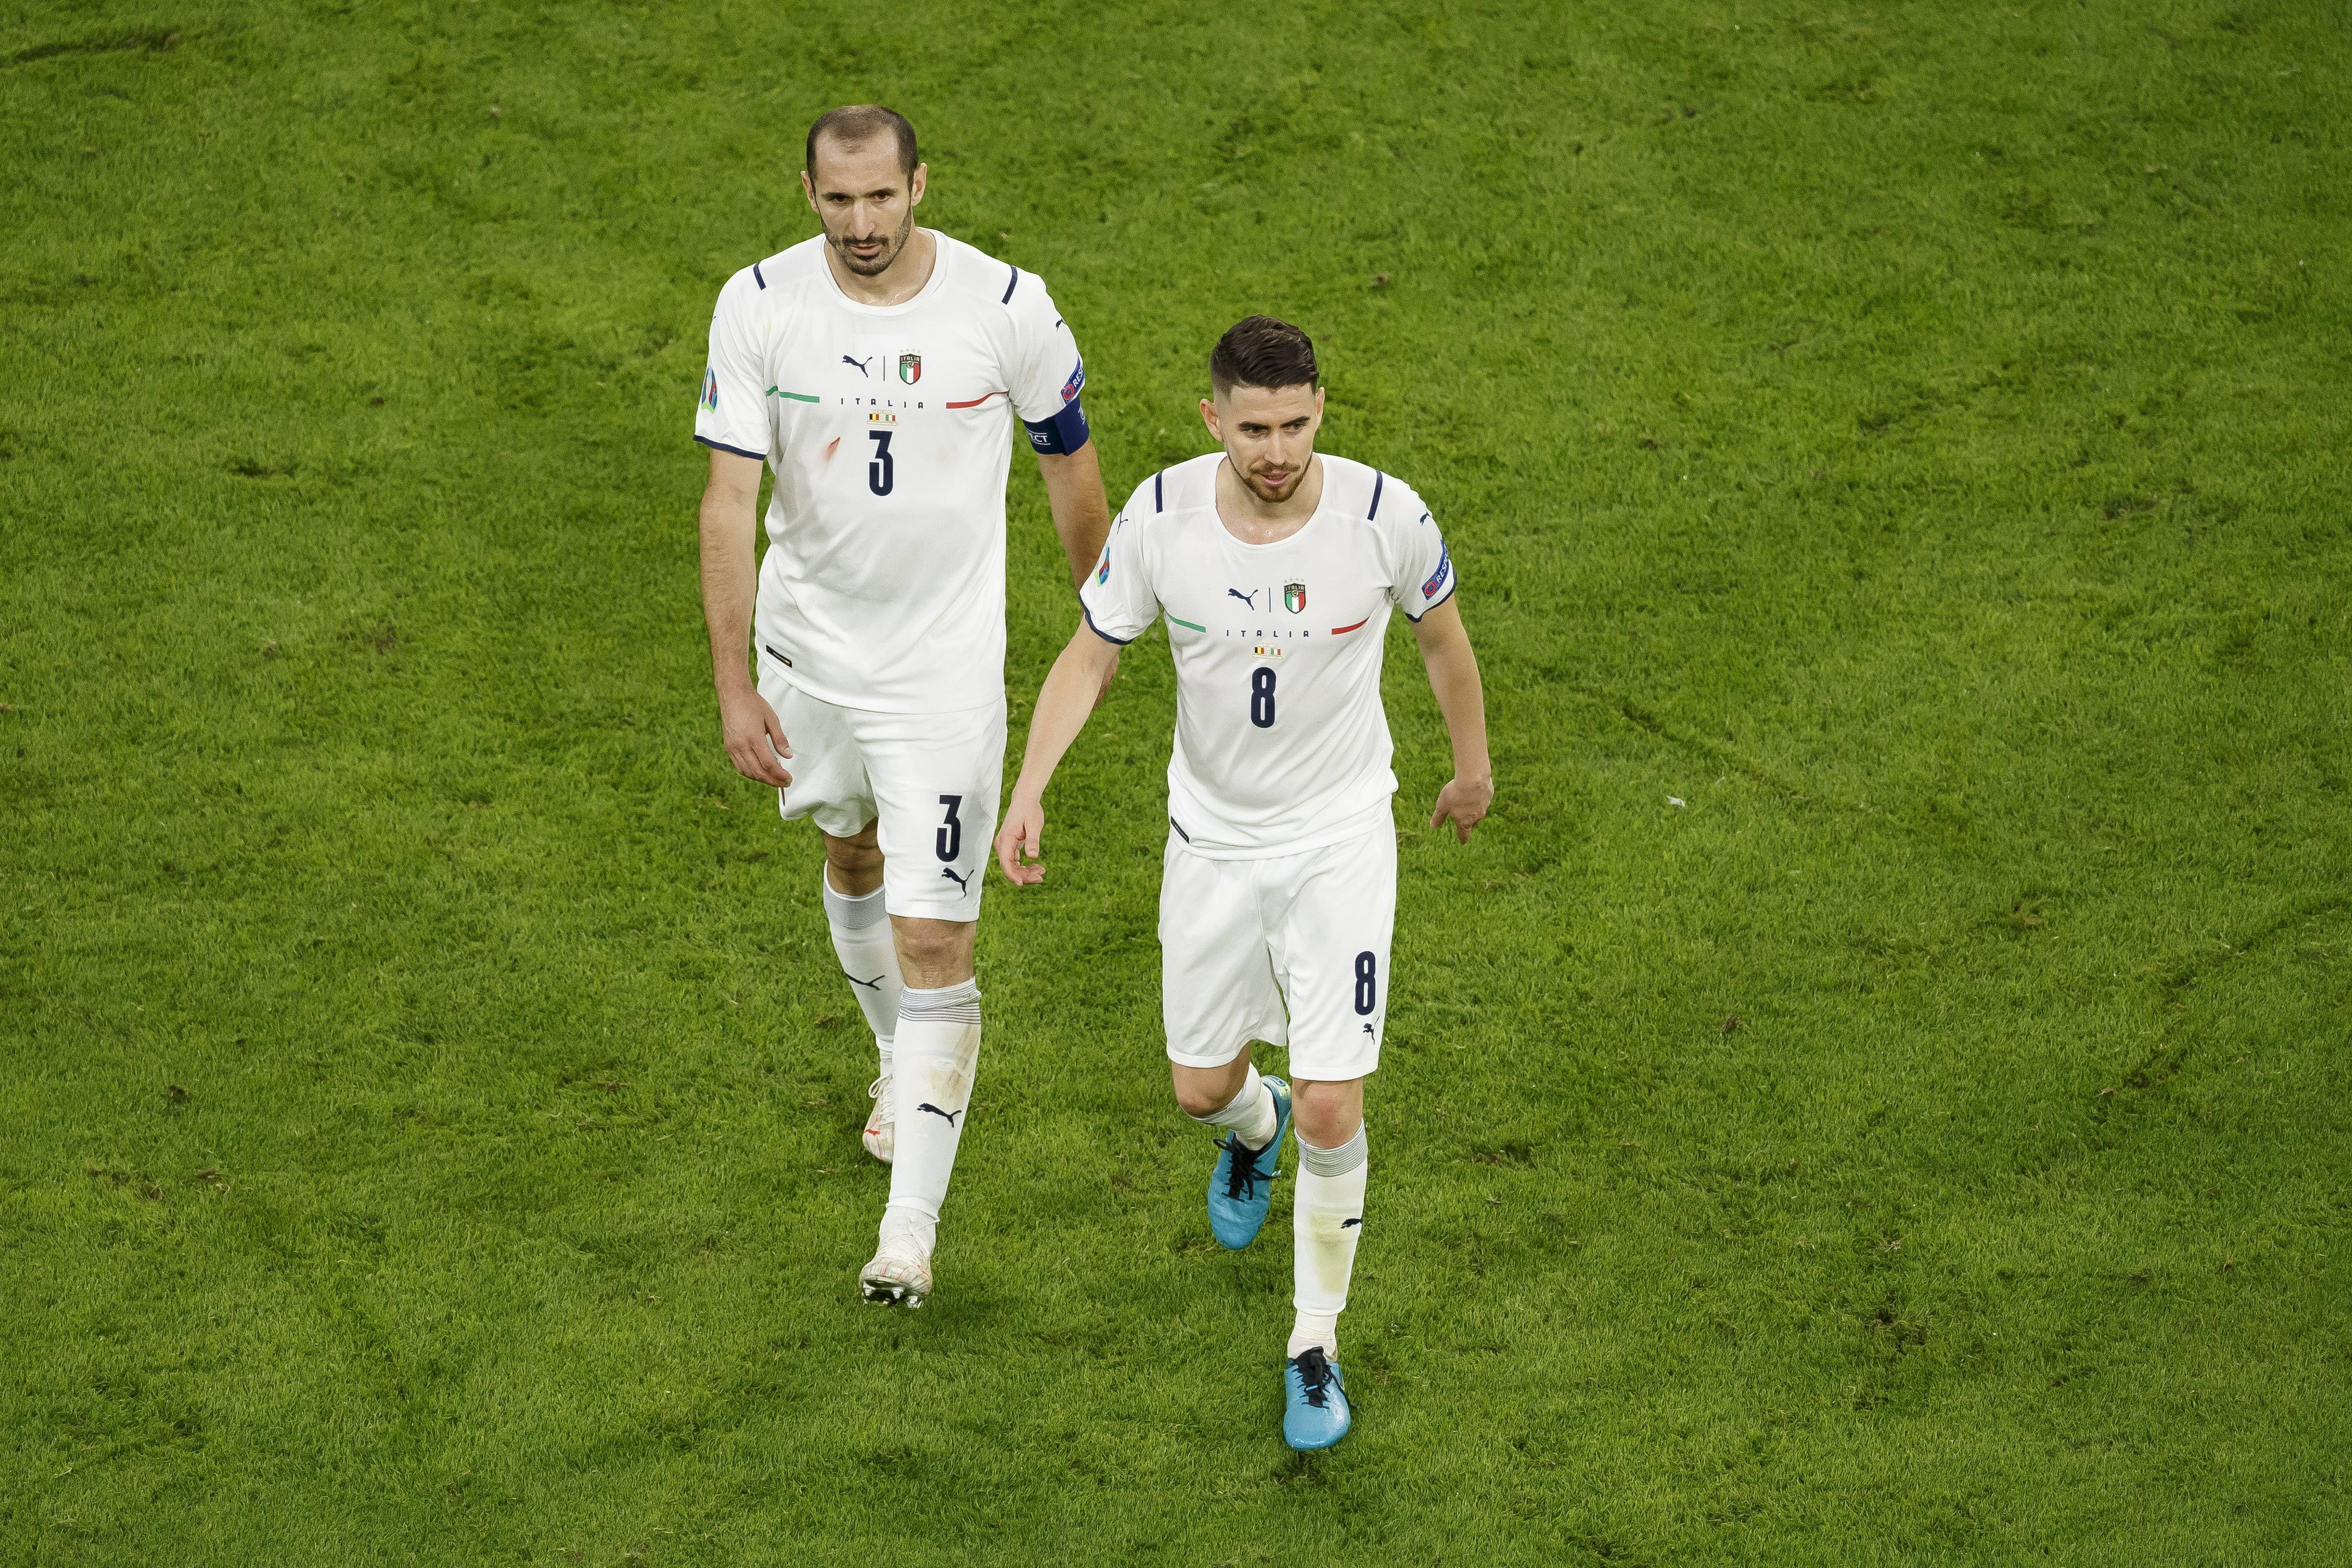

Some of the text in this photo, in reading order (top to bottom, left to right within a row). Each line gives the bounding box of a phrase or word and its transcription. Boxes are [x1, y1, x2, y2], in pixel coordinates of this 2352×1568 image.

[841, 398, 924, 409] ITALIA
[869, 430, 893, 496] 3
[1028, 433, 1047, 442] ECT
[1226, 630, 1309, 638] ITALIA
[1251, 667, 1277, 728] 8
[936, 795, 962, 862] 3
[1355, 951, 1376, 1016] 8
